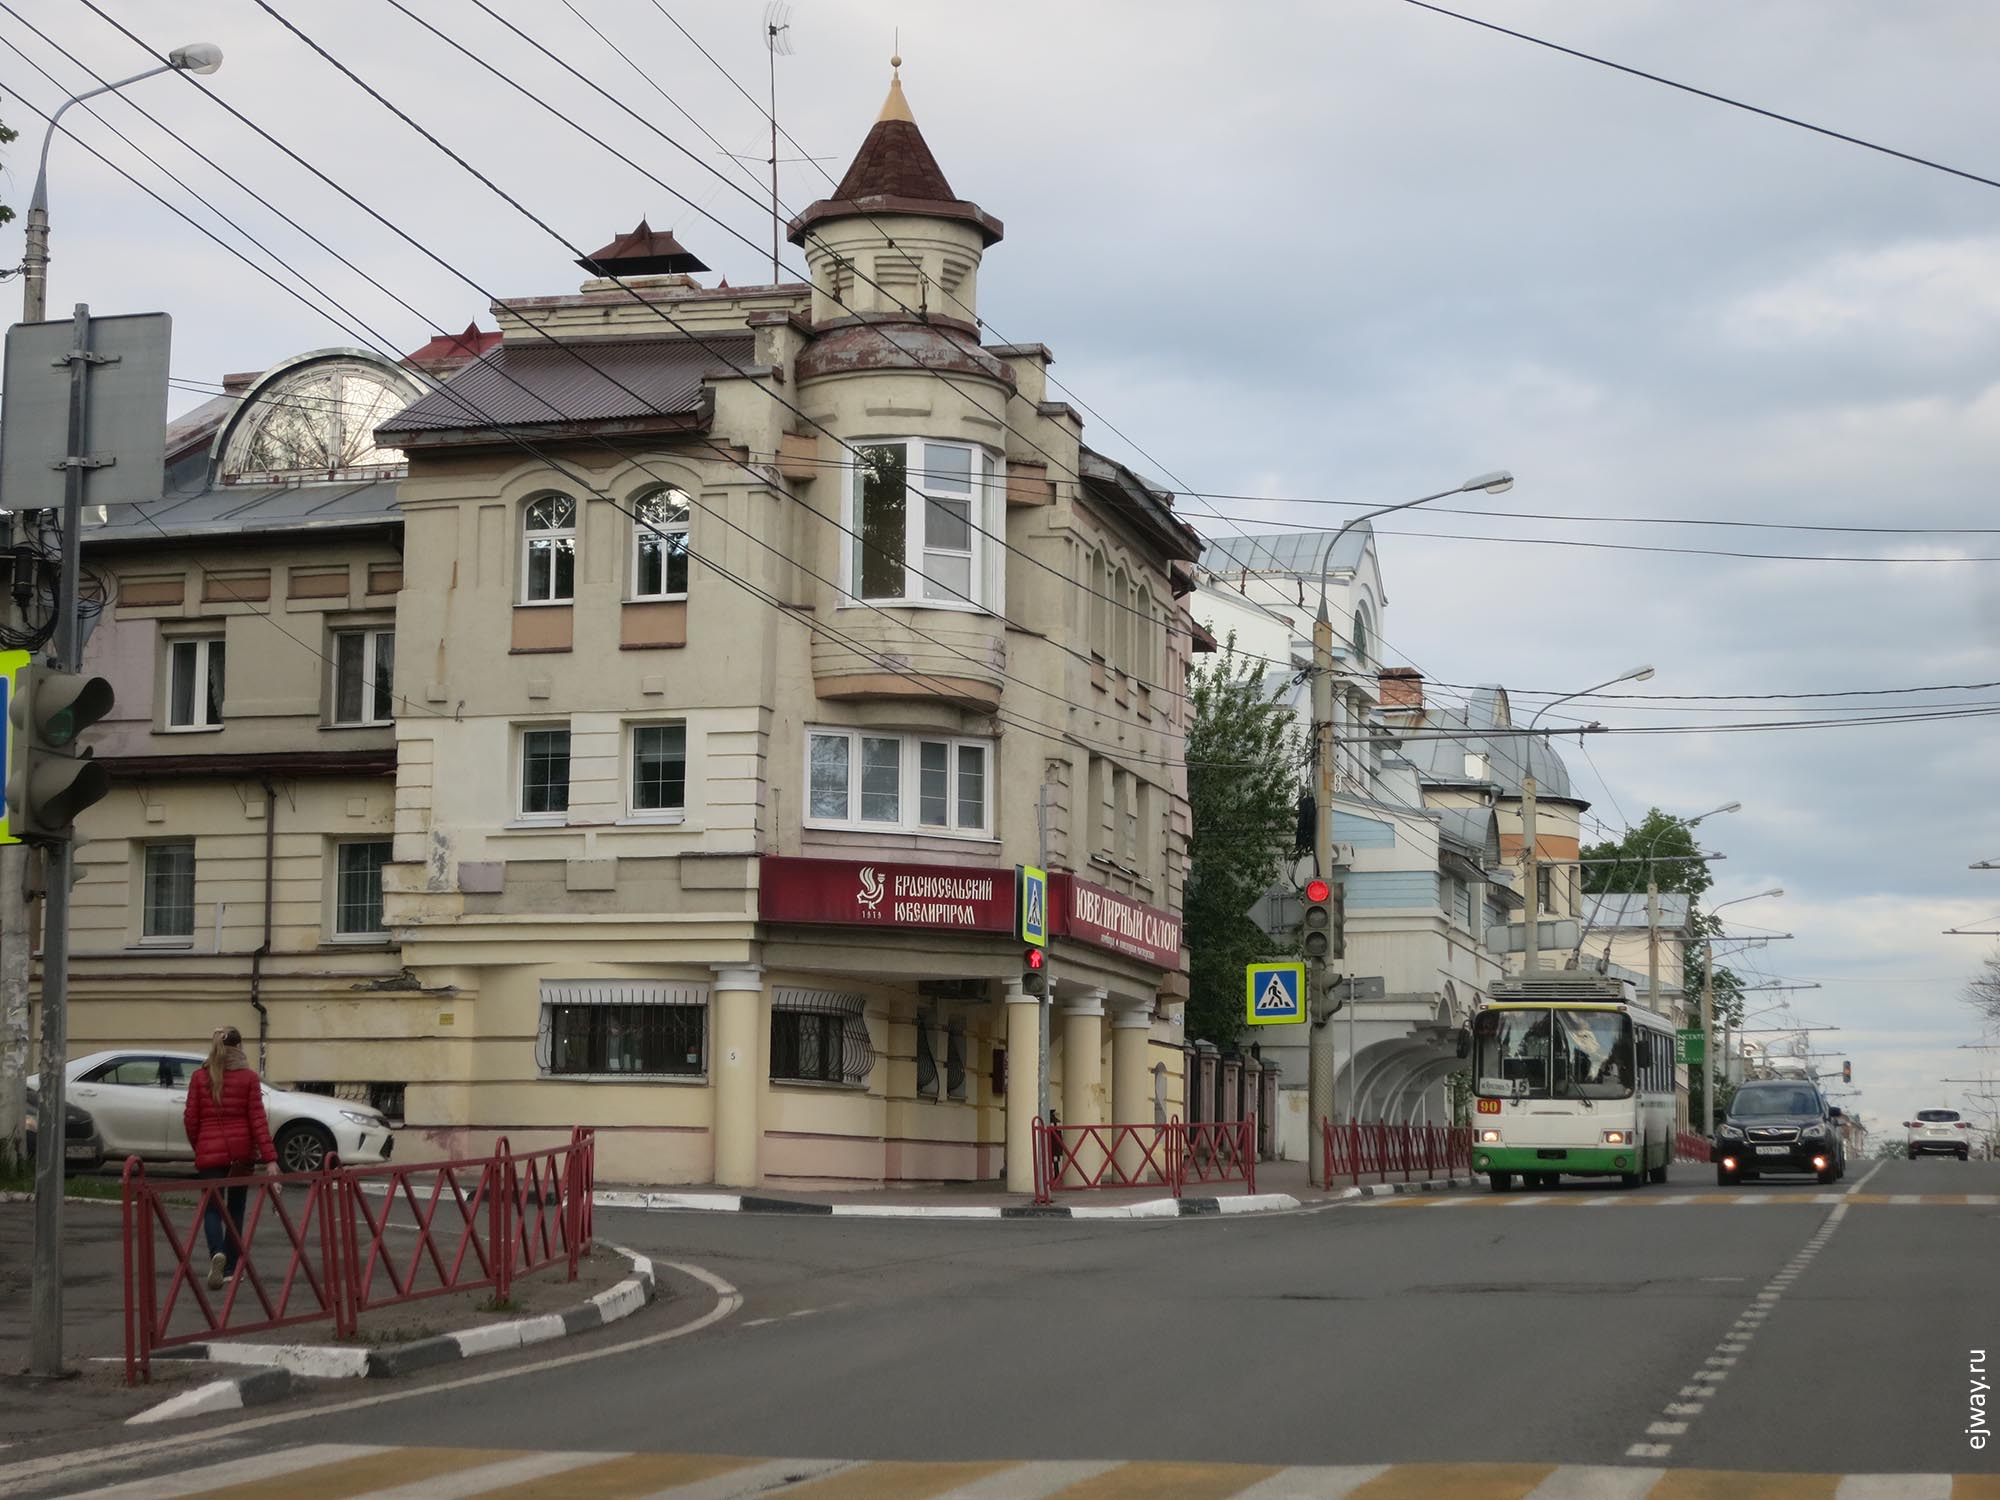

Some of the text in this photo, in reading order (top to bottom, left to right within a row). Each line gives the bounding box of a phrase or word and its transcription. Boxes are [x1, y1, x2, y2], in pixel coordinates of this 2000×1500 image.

[895, 875, 992, 901] КРАСНОСЕЛЬСКИЙ
[895, 902, 976, 925] ЮВЕЛИРПРОМ
[1076, 886, 1143, 941] ЮВЕЛИРНЫЙ
[1145, 914, 1178, 953] САЛОН
[1677, 1033, 1686, 1058] JAZZ
[1480, 1101, 1498, 1112] 90
